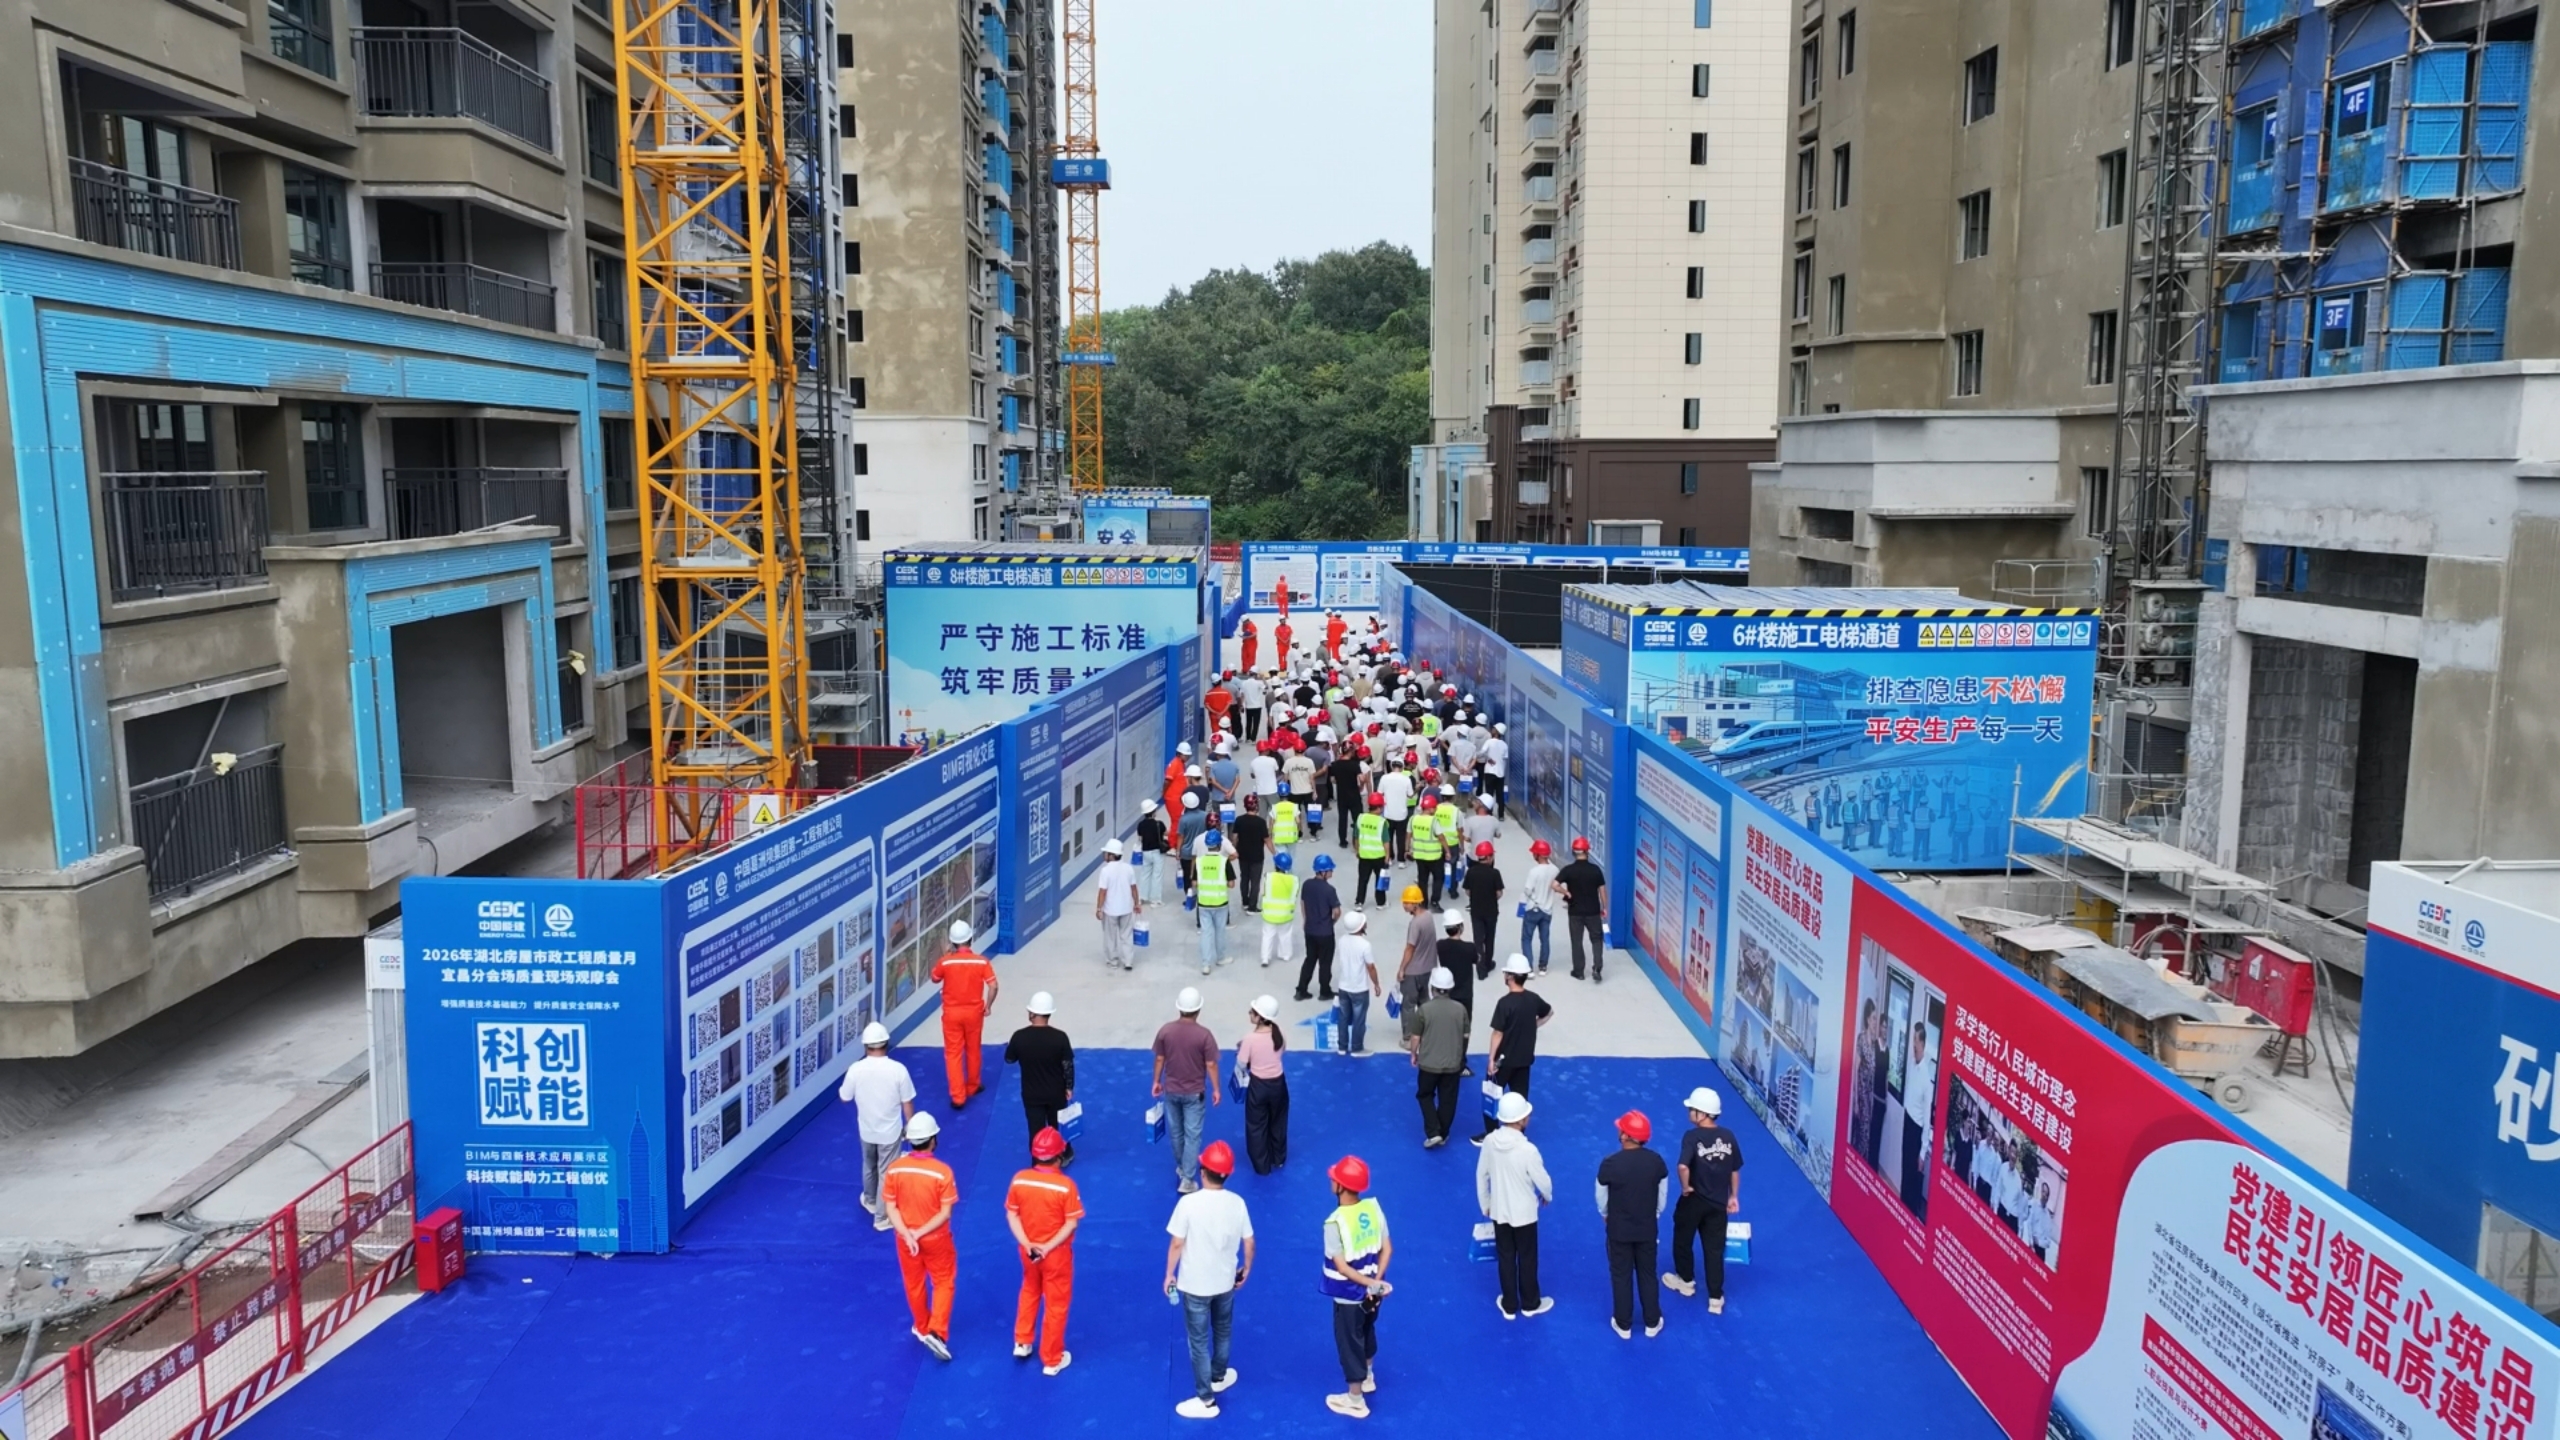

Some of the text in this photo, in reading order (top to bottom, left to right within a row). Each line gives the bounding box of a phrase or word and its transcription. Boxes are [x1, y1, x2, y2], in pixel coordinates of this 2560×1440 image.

[2347, 92, 2365, 113] 4F
[2325, 307, 2344, 327] 3F
[1097, 529, 1137, 545] 安全
[950, 566, 1054, 587] 8#楼施工电梯通道
[939, 623, 1147, 652] 严守施工标准
[1733, 622, 1901, 649] 6#楼施工电梯通道
[1866, 676, 2066, 706] 排查隐患不松懈
[1865, 716, 2065, 745] 平安生产每一天
[942, 738, 996, 785] BIM可视化交底
[733, 812, 843, 881] 中国葛洲坝集团第一工程有限公司
[1746, 824, 1824, 906] 党建引领匠心筑品
[1745, 855, 1822, 941] 民生安居品质建设
[478, 920, 526, 933] 中国能建
[2417, 919, 2450, 940] 中国能建
[422, 948, 637, 966] 2026年湖北房屋市政工程质量月
[441, 968, 620, 985] 宜昌分会场质量现场观摩会
[482, 1027, 581, 1073] 科创
[1954, 1004, 2077, 1119] 深学笃行人民城市理念
[484, 1075, 585, 1121] 赋能
[1951, 1036, 2074, 1155] 党建赋能民生安居建设
[465, 1150, 609, 1163] BIM与四新技术应用展示区
[466, 1170, 609, 1186] 科技赋能助力工程创优
[357, 1183, 403, 1231] 禁止跨越
[462, 1226, 619, 1239] 中国葛洲坝集团第一工程有限公司
[2228, 1160, 2537, 1424] 党建引领匠心筑品
[120, 1284, 276, 1411] 严禁抛物 禁止跨越
